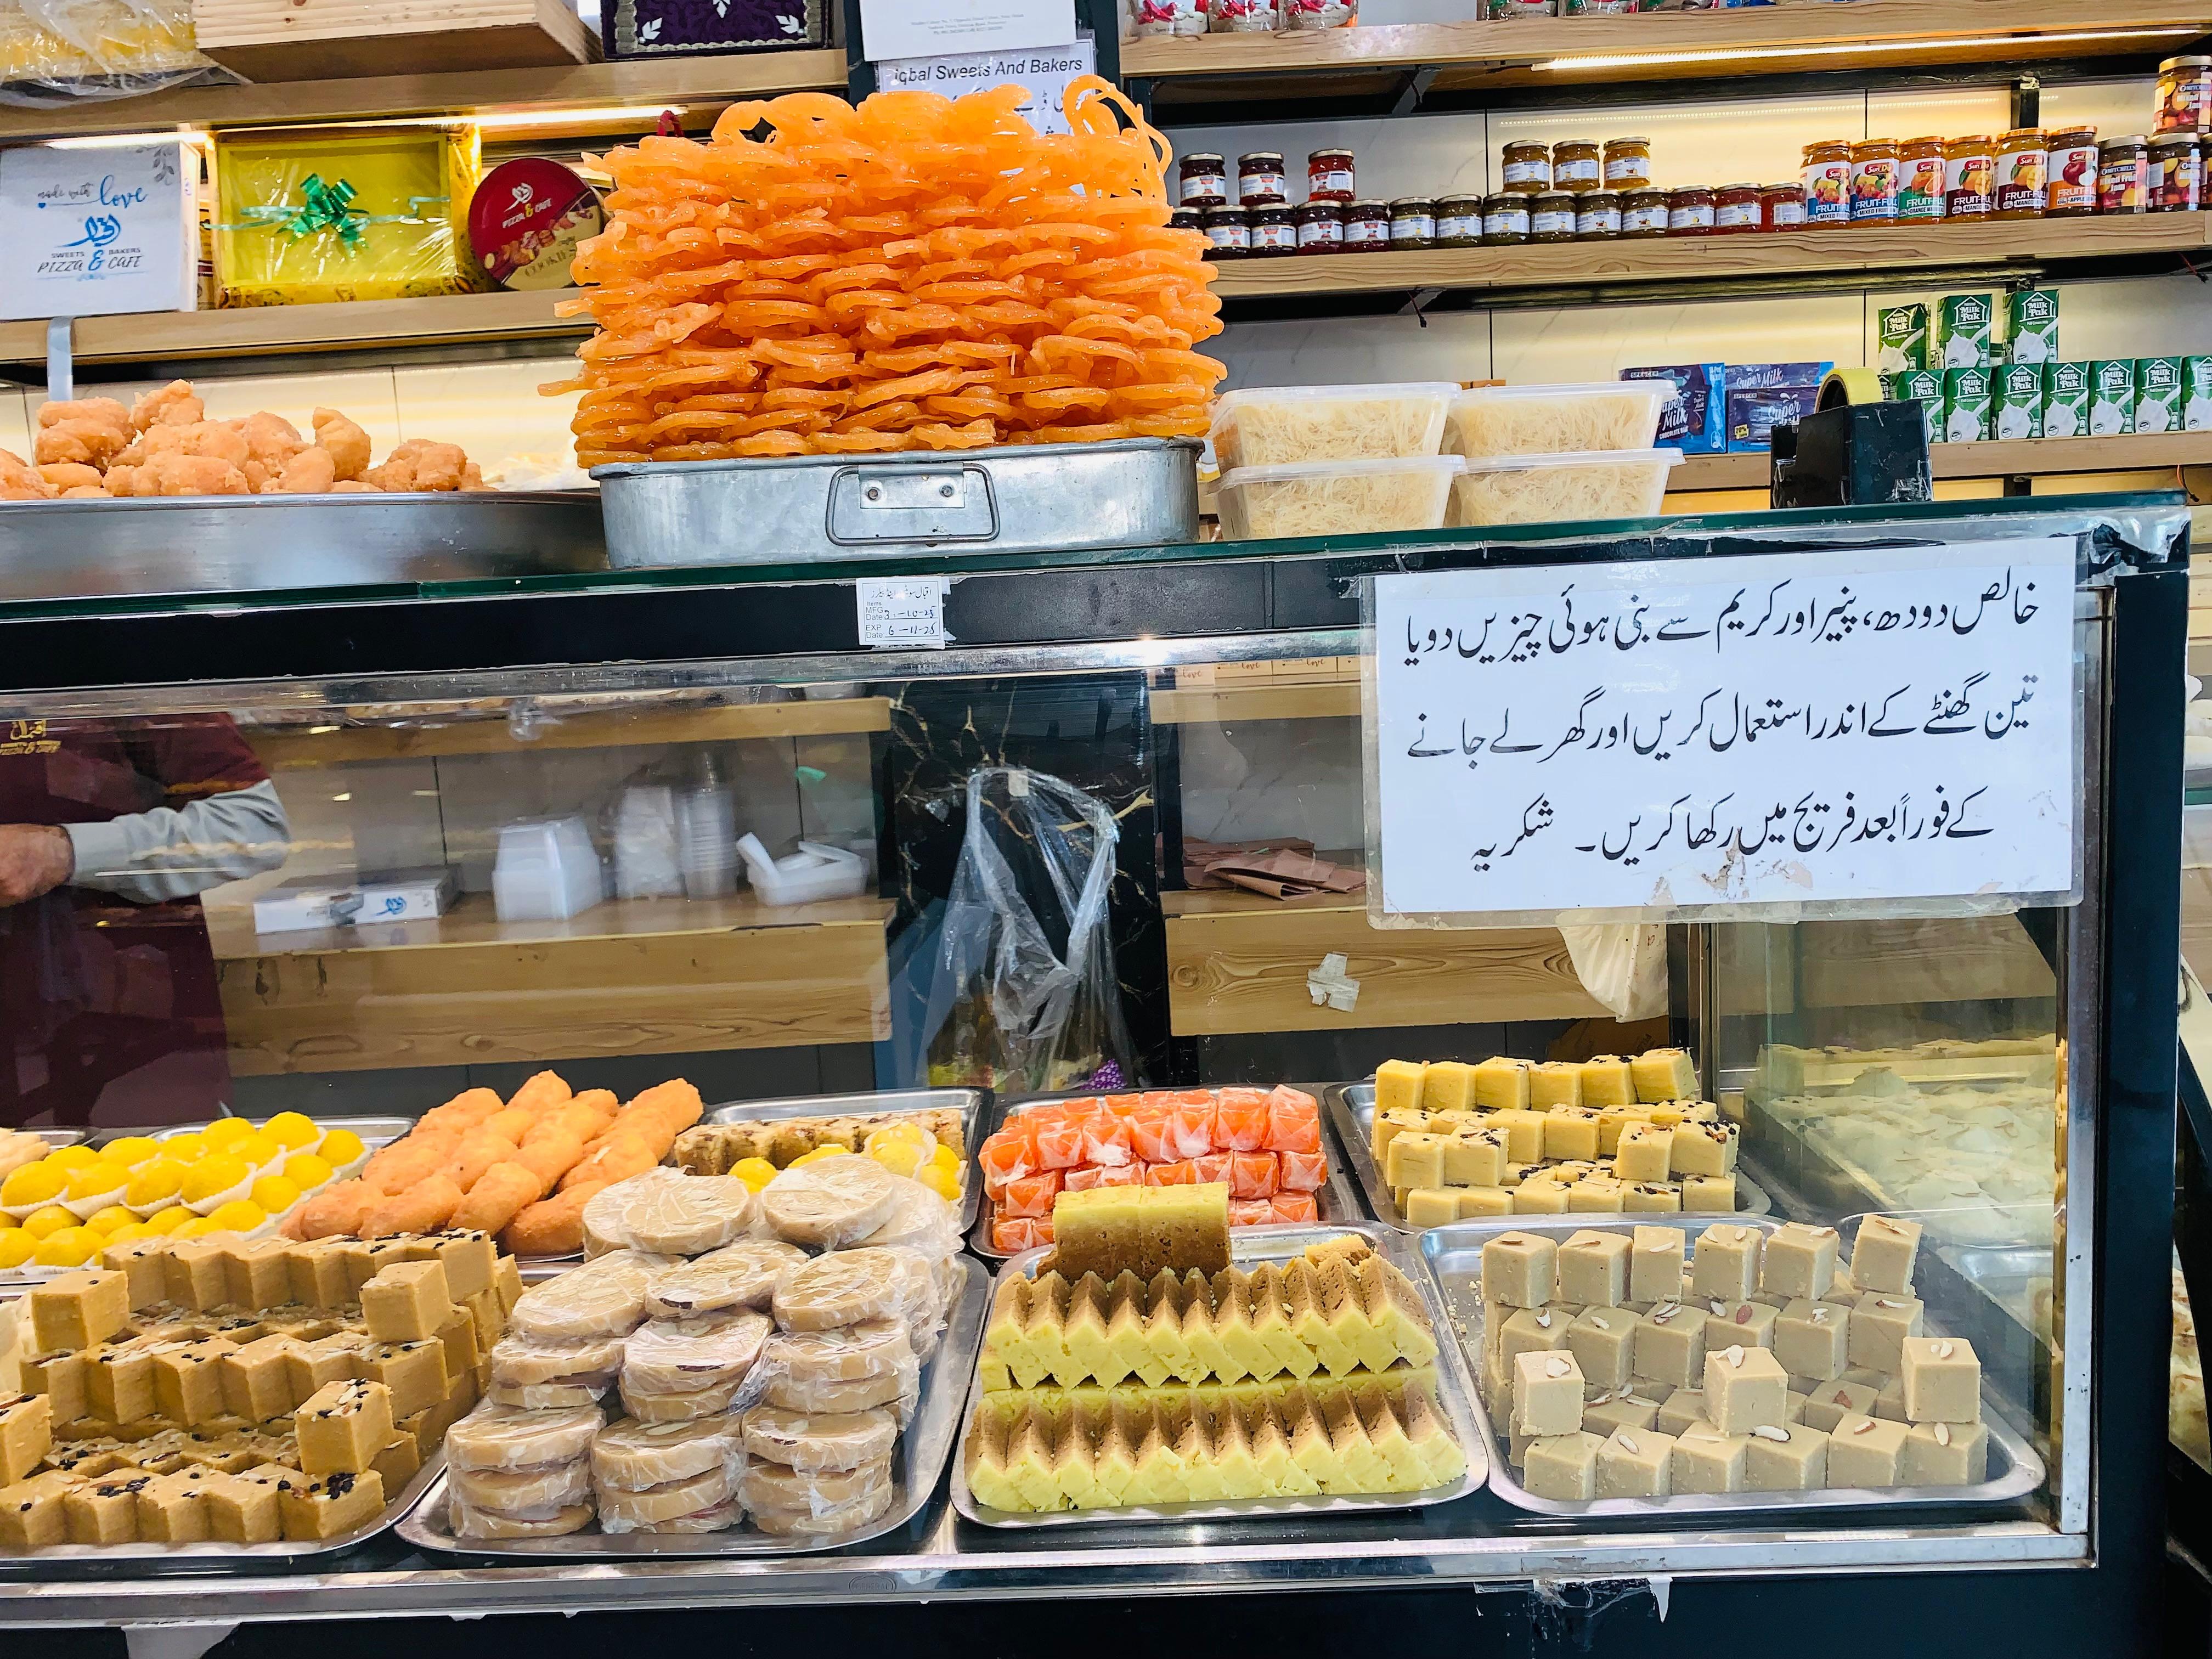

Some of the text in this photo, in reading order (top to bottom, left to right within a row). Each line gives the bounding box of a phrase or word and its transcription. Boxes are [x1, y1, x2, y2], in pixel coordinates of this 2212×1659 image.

[936, 65, 990, 80] Sweets
[995, 60, 1025, 76] And
[1030, 58, 1083, 74] Bakers
[99, 174, 149, 209] love
[109, 247, 141, 255] BAKERS
[1888, 315, 1909, 324] Milk
[1889, 322, 1908, 332] Pak
[1961, 313, 1980, 321] Pak
[2028, 308, 2047, 317] Pak
[1736, 371, 1762, 389] Super
[1761, 368, 1783, 388] Milk
[1914, 381, 1934, 389] Milk
[1915, 387, 1934, 396] Pak
[1962, 386, 1982, 394] Pak
[2012, 382, 2032, 390] Pak
[2059, 380, 2079, 388] Pak
[2104, 377, 2124, 386] Pak
[2151, 375, 2171, 384] Pak
[2199, 374, 2212, 382] Pa
[1662, 394, 1686, 416] uper
[1662, 407, 1689, 431] Milk
[1768, 400, 1801, 424] Super
[1659, 428, 1680, 440] CHOCOLATE
[916, 586, 932, 599] اقبال
[1952, 566, 2039, 635] خالص
[1549, 584, 1610, 654] ہوئی
[1615, 594, 1651, 651] بنی
[1656, 616, 1711, 641] سے
[1718, 578, 1792, 653] کریم
[1773, 597, 1815, 635] اور
[1811, 585, 1858, 644] پنیر
[1458, 611, 1543, 664] چیزیں
[1810, 701, 1866, 740] اندر
[1868, 684, 1917, 737] کے
[1923, 671, 1991, 735] گھنٹے
[1984, 674, 2039, 740] تین
[1489, 708, 1544, 753] لے
[1536, 685, 1607, 764] گھر
[1585, 712, 1628, 750] اور
[1633, 687, 1723, 761] کریں
[1709, 691, 1811, 752] استعمال
[1686, 792, 1735, 849] رکھا
[1738, 802, 1787, 856] میں
[1793, 791, 1857, 853] فریج
[1850, 804, 1896, 843] بعد
[1945, 785, 1995, 838] کے
[1470, 792, 1554, 872] شکریہ
